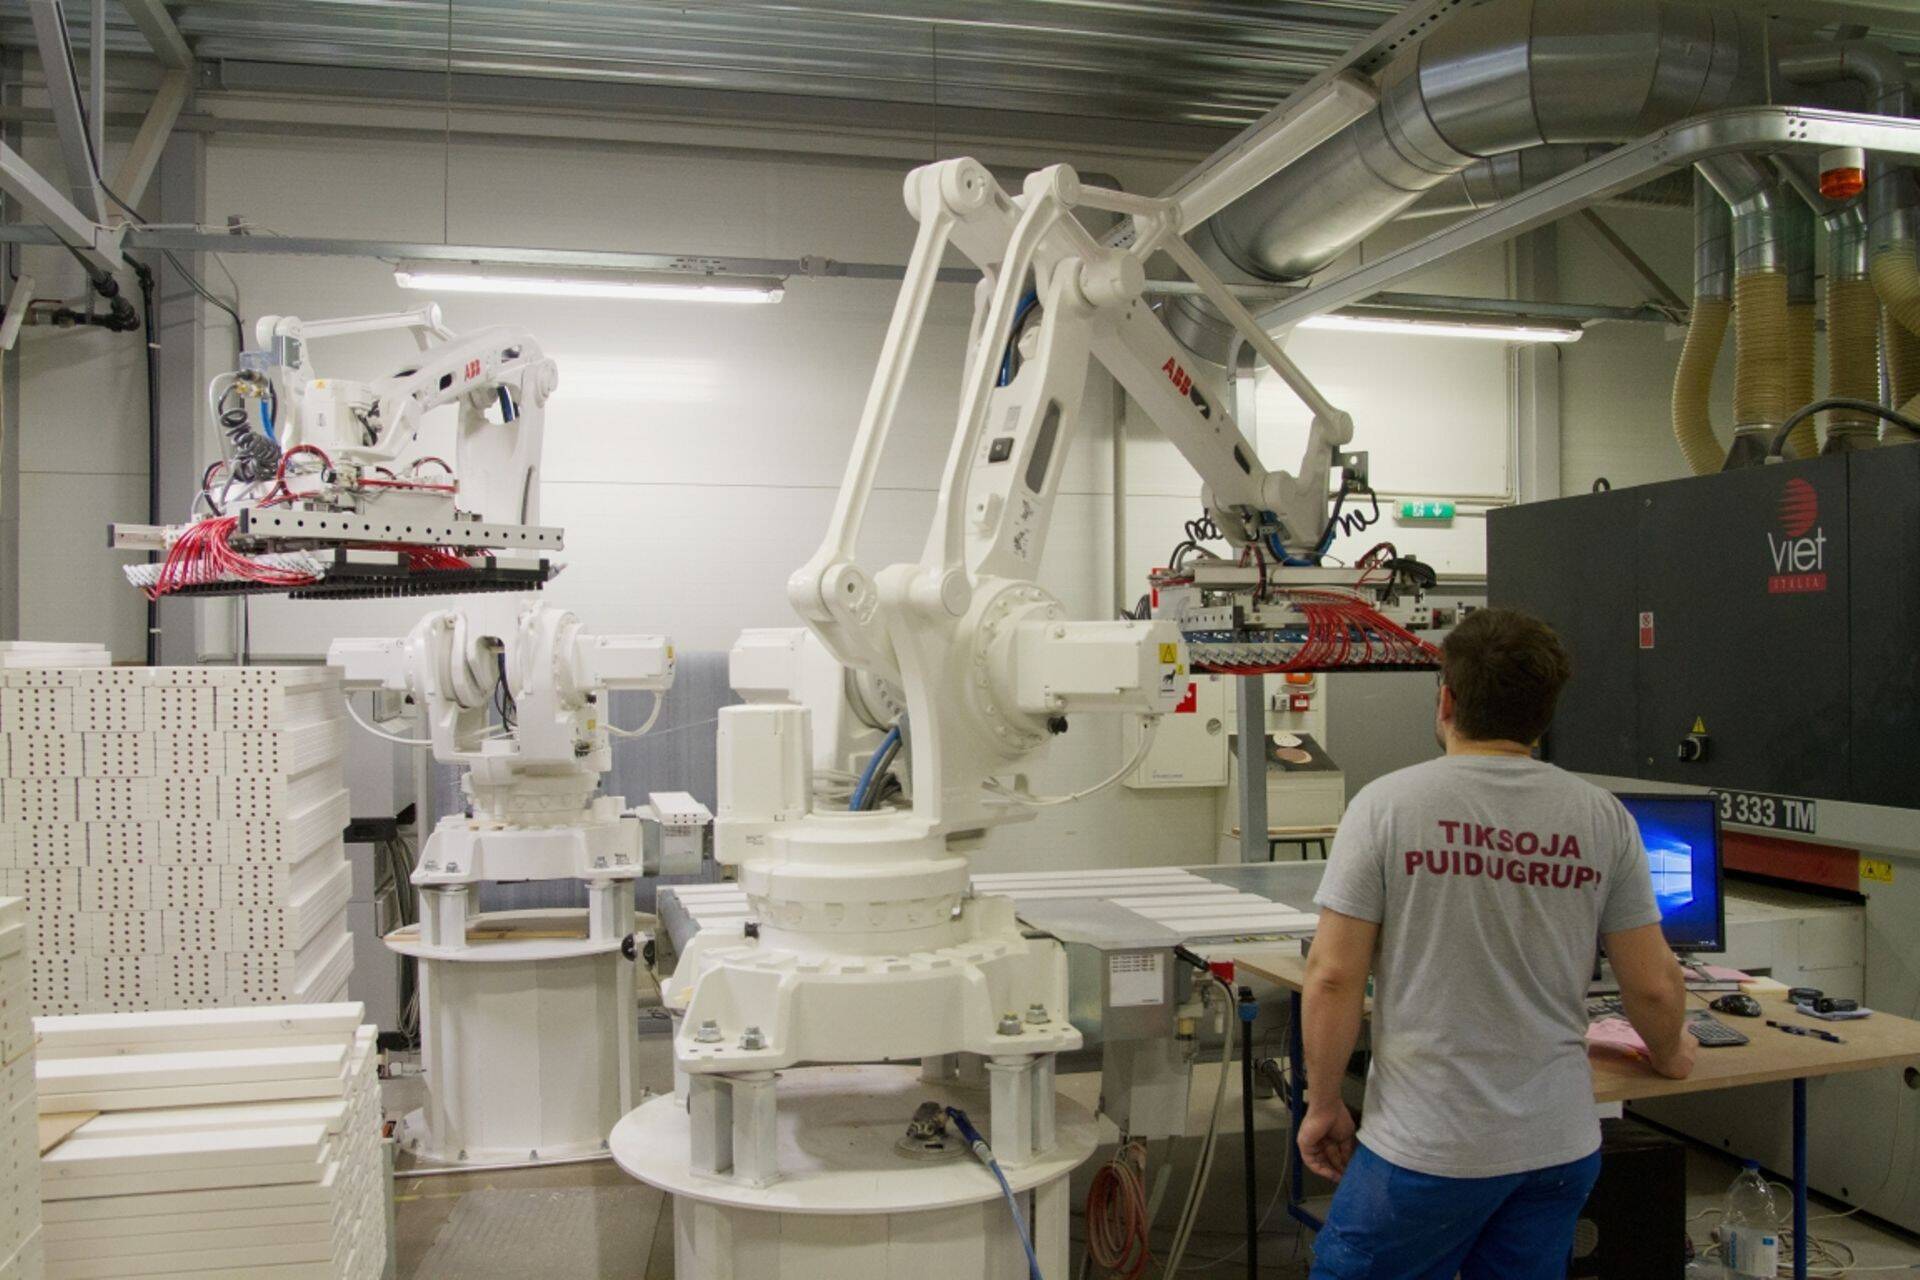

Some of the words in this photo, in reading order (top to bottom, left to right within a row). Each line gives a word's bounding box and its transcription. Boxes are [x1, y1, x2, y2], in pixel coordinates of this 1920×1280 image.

[464, 359, 481, 382] ABB
[1162, 356, 1191, 396] ABB
[1767, 527, 1827, 574] Viet
[1736, 794, 1776, 827] 333
[1782, 799, 1815, 832] TM
[1438, 819, 1582, 860] TIKSOJA
